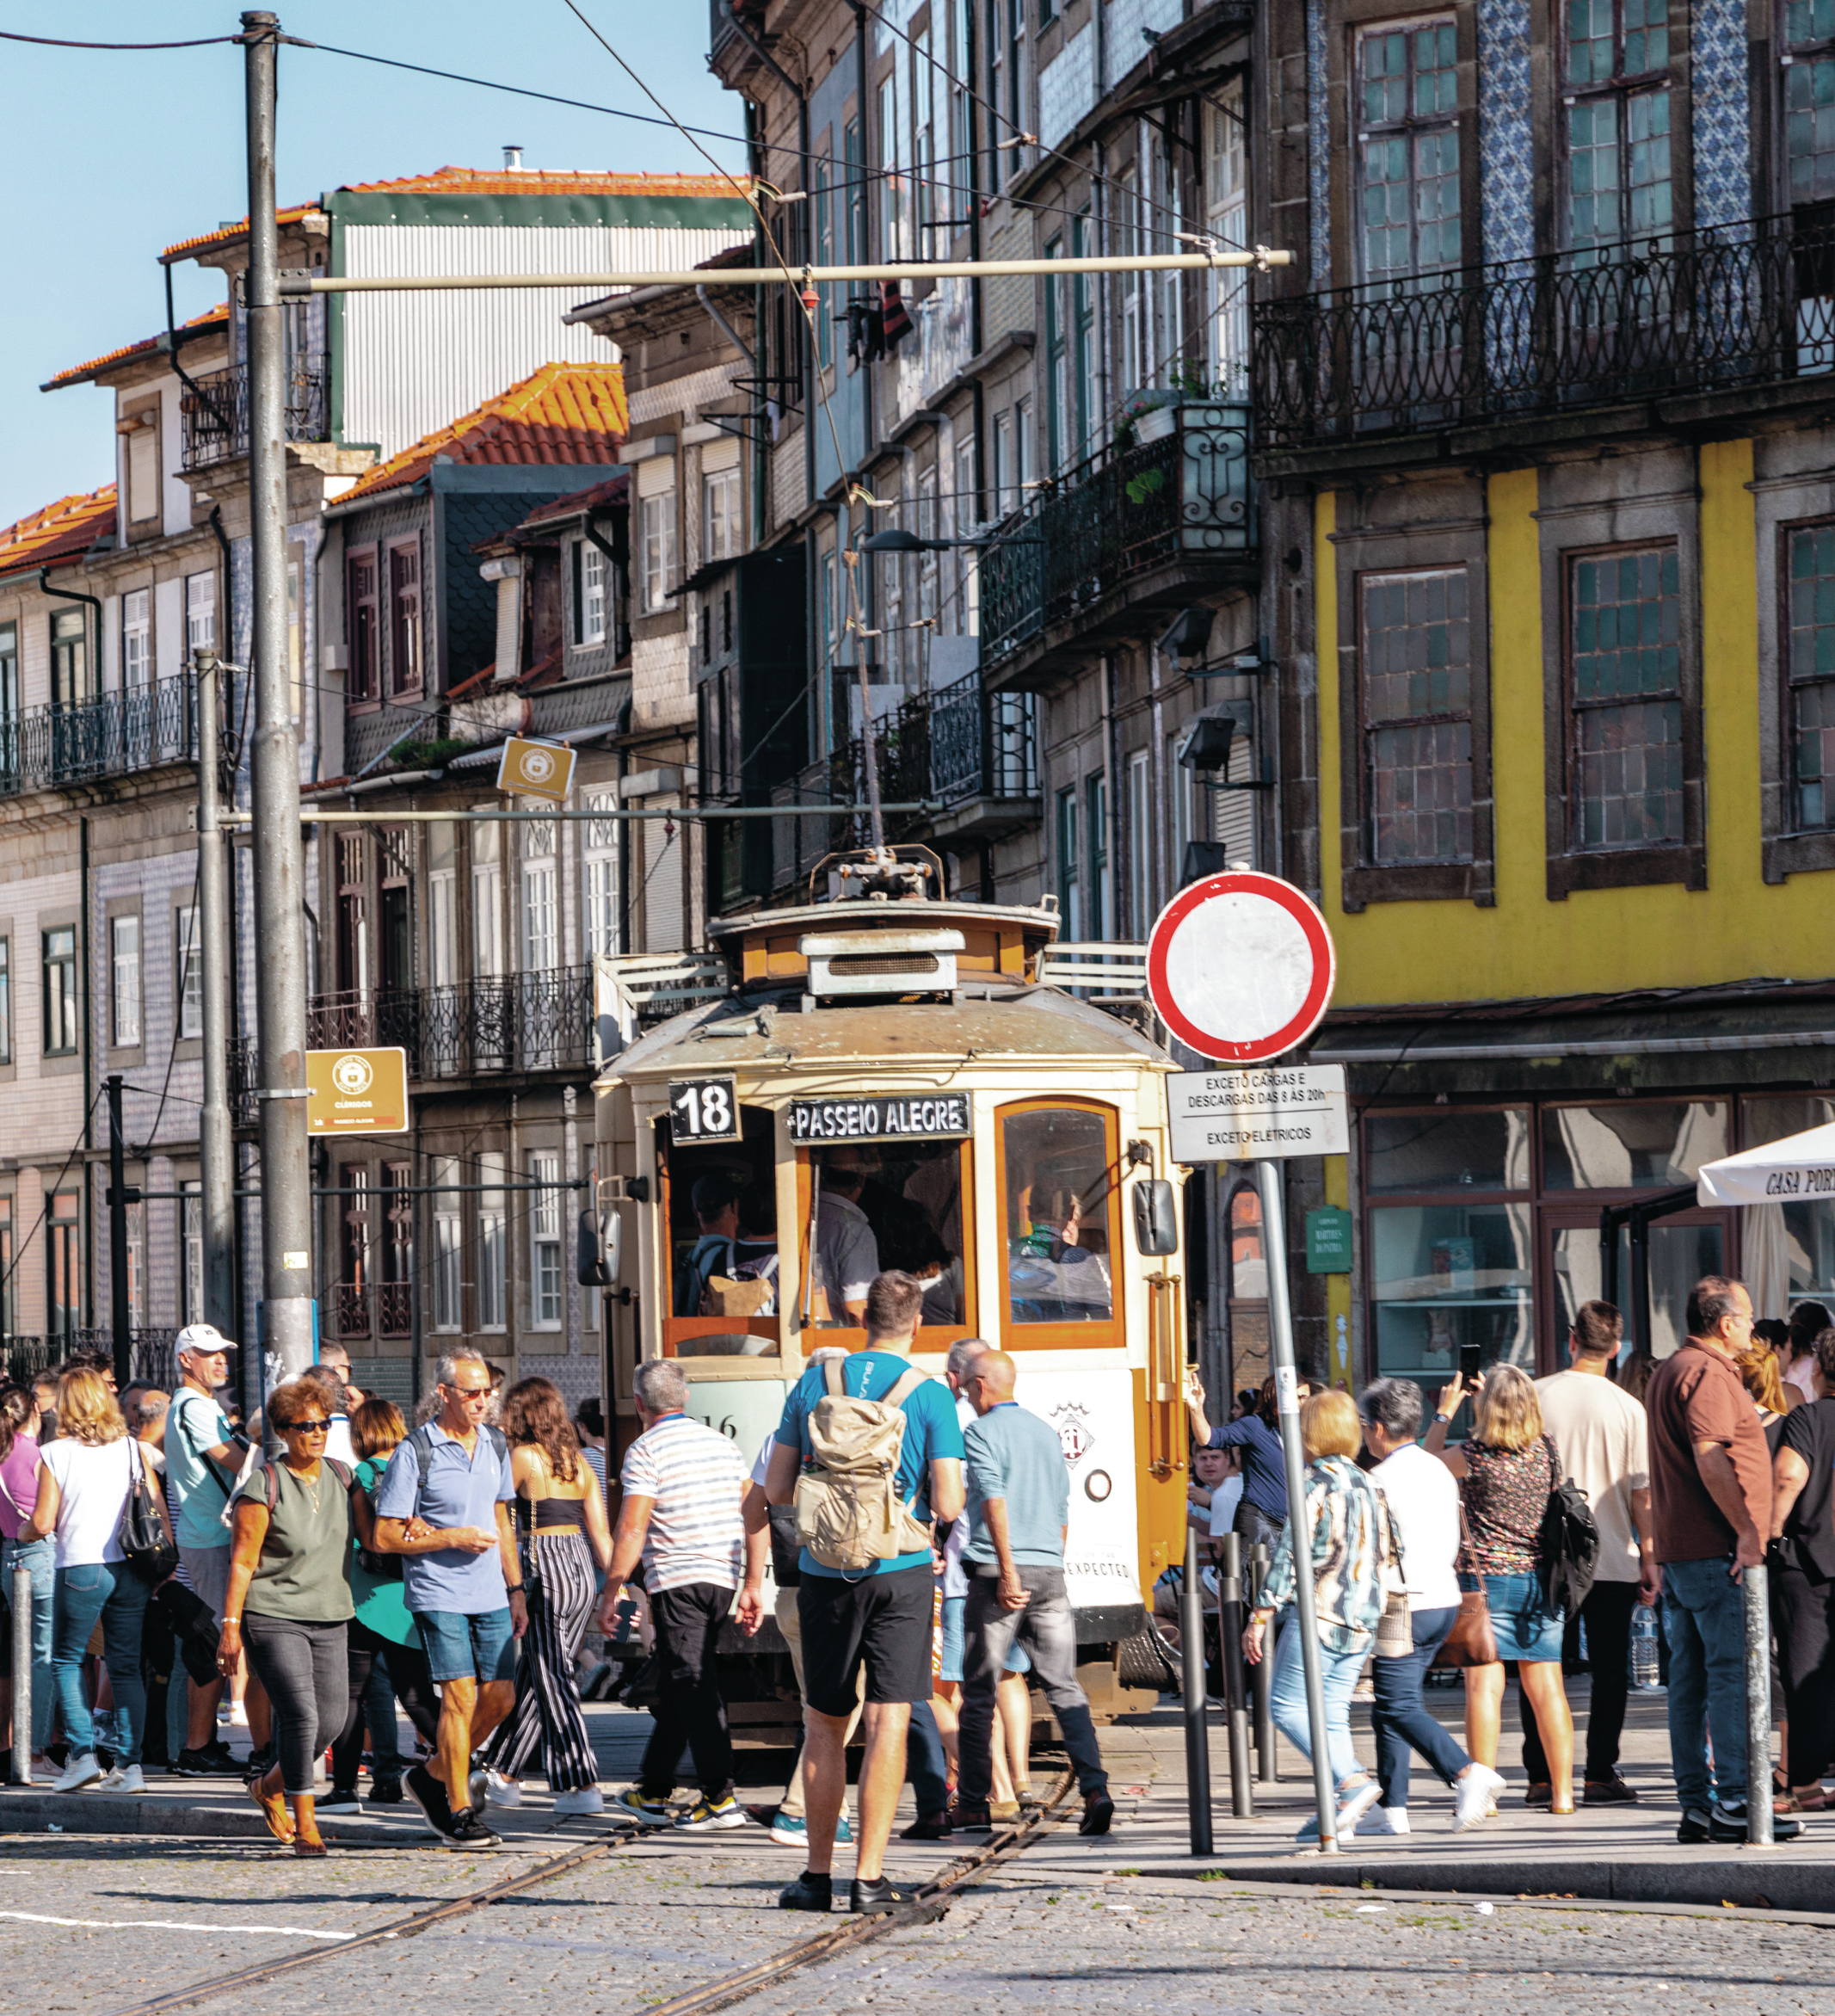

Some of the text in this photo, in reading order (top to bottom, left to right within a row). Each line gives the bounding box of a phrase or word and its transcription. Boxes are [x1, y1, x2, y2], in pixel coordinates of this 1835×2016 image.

[1206, 1072, 1306, 1090] EXCETO CARGAS E
[1188, 1088, 1326, 1108] DESCARGAS DAS 8 ÀS 20h
[676, 1085, 731, 1134] 18
[796, 1099, 964, 1138] PASSEIO ALEGRE
[1207, 1126, 1312, 1145] EXCETO ELÉTRICOS
[1765, 1168, 1835, 1195] CASA POR
[1062, 1562, 1130, 1578] EXPECTED
